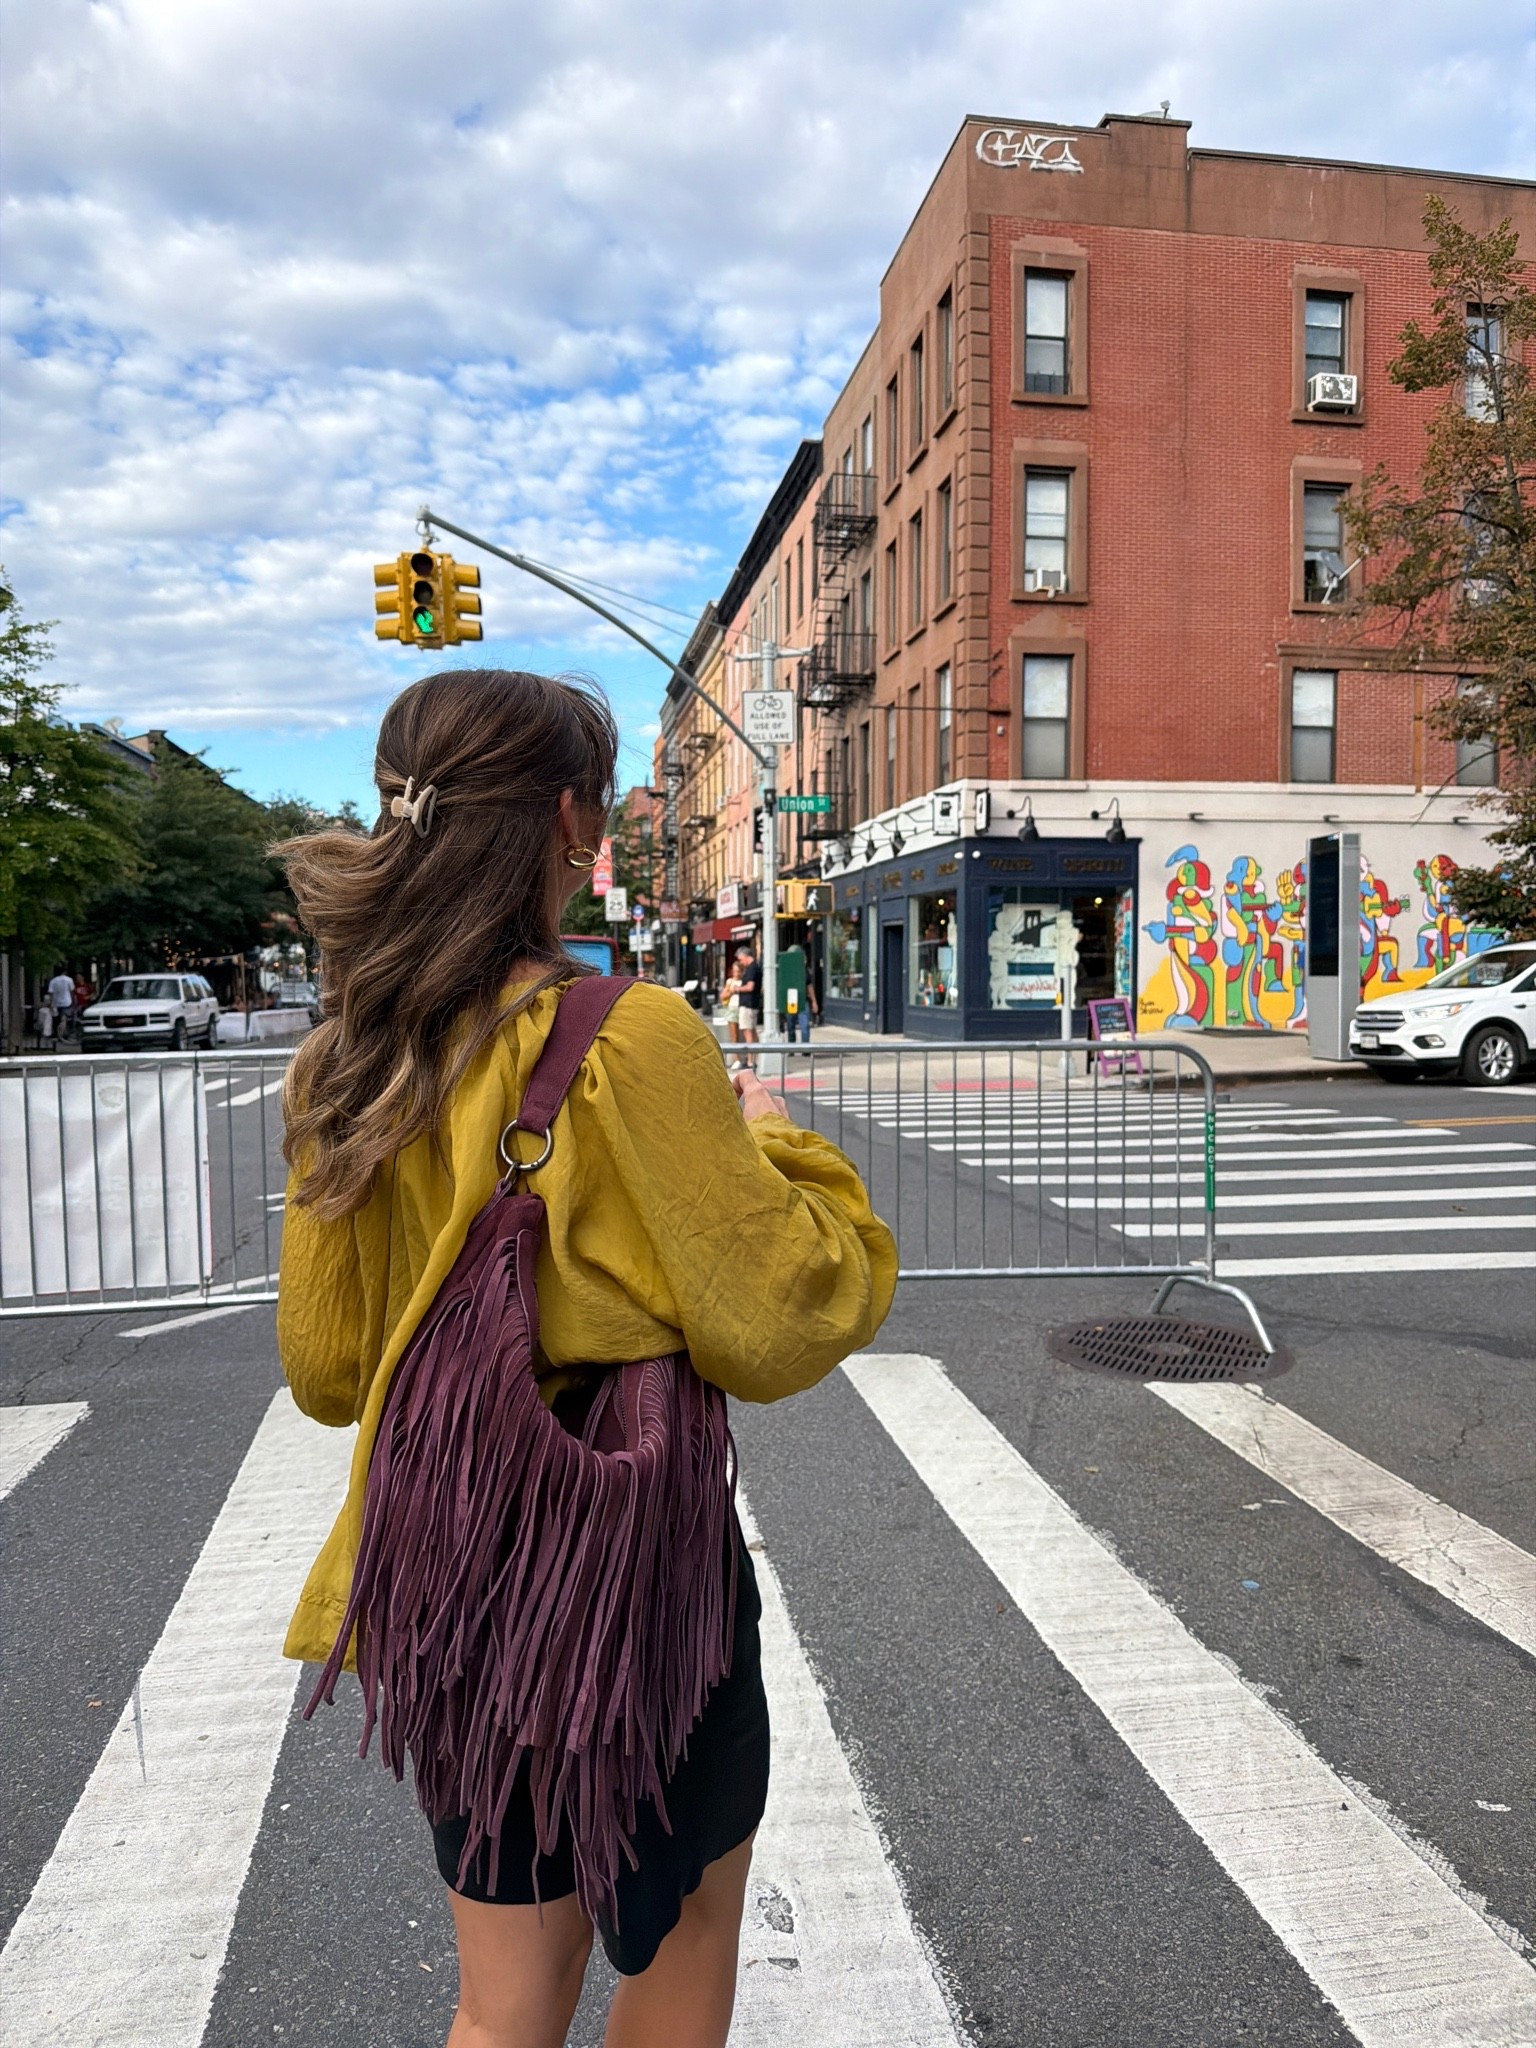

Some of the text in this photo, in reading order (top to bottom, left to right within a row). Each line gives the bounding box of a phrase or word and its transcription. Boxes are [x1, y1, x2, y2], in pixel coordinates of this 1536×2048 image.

[754, 722, 783, 730] USE OF
[781, 798, 815, 811] Union
[610, 901, 624, 911] 25
